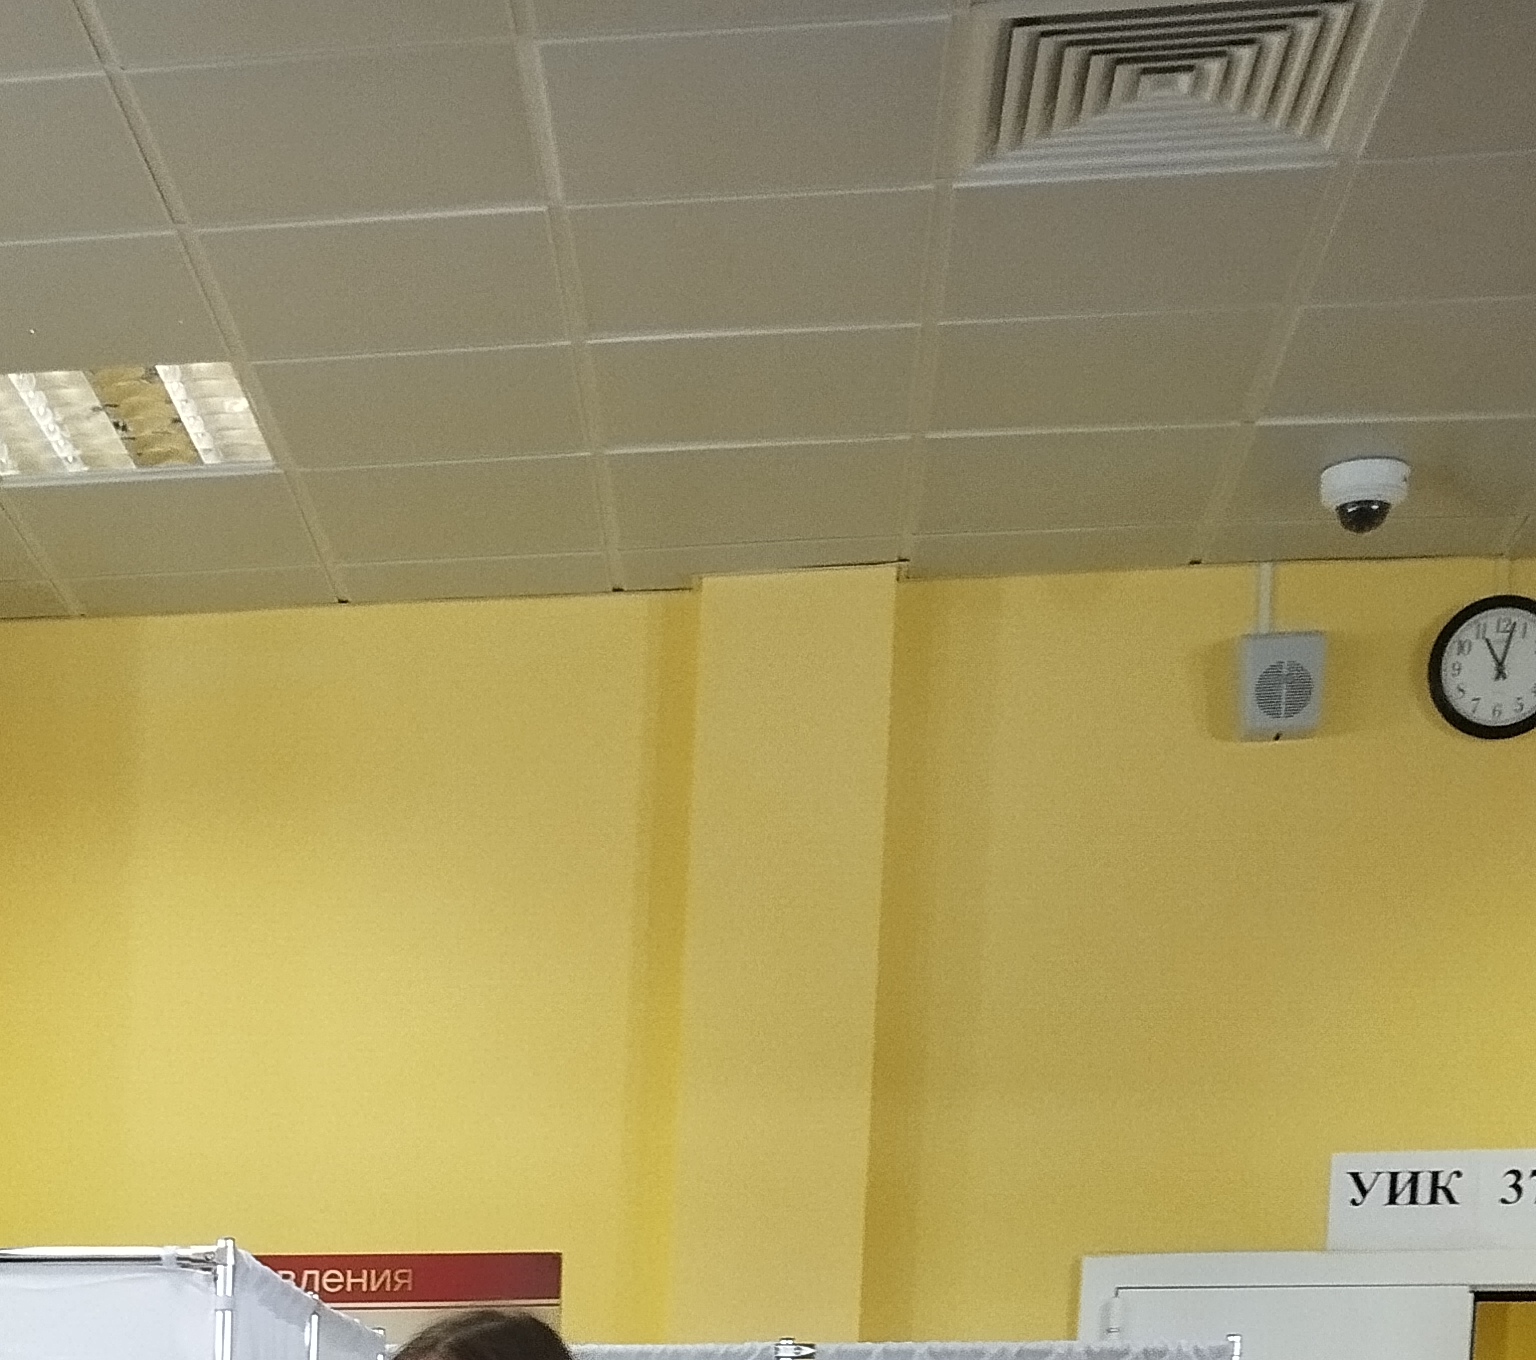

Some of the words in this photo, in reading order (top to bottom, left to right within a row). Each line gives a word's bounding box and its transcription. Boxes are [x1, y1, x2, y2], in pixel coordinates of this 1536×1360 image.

[1451, 661, 1462, 678] 9
[1471, 697, 1481, 714] 7
[1492, 702, 1502, 718] 6
[1346, 1169, 1464, 1207] УИК
